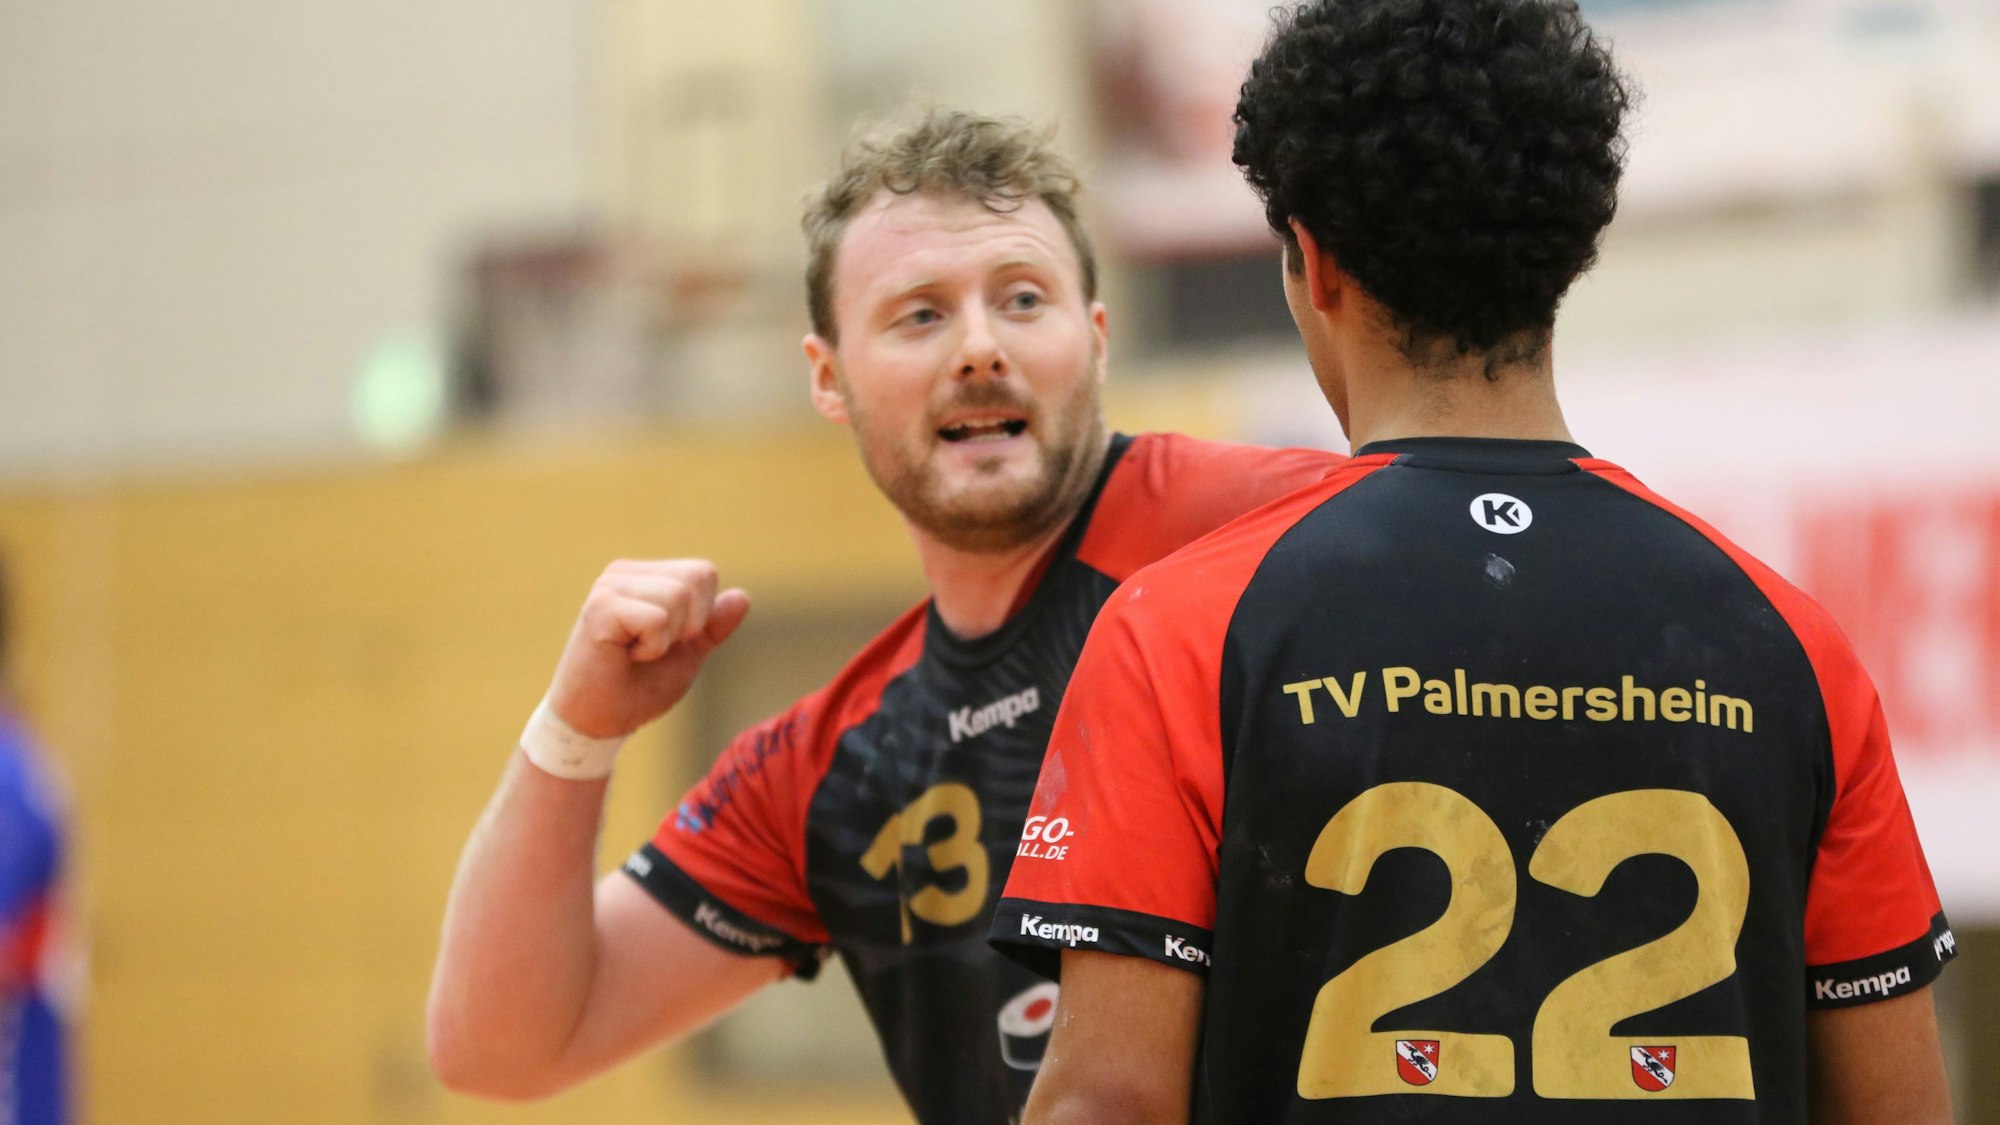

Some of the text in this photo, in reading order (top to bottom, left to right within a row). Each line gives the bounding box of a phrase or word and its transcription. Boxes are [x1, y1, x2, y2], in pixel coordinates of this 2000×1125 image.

[948, 686, 1040, 743] Kempa
[1283, 667, 1754, 733] TV Palmersheim
[1020, 913, 1100, 947] Kempa
[1297, 781, 1756, 1101] 22
[1814, 965, 1912, 1001] Kempa
